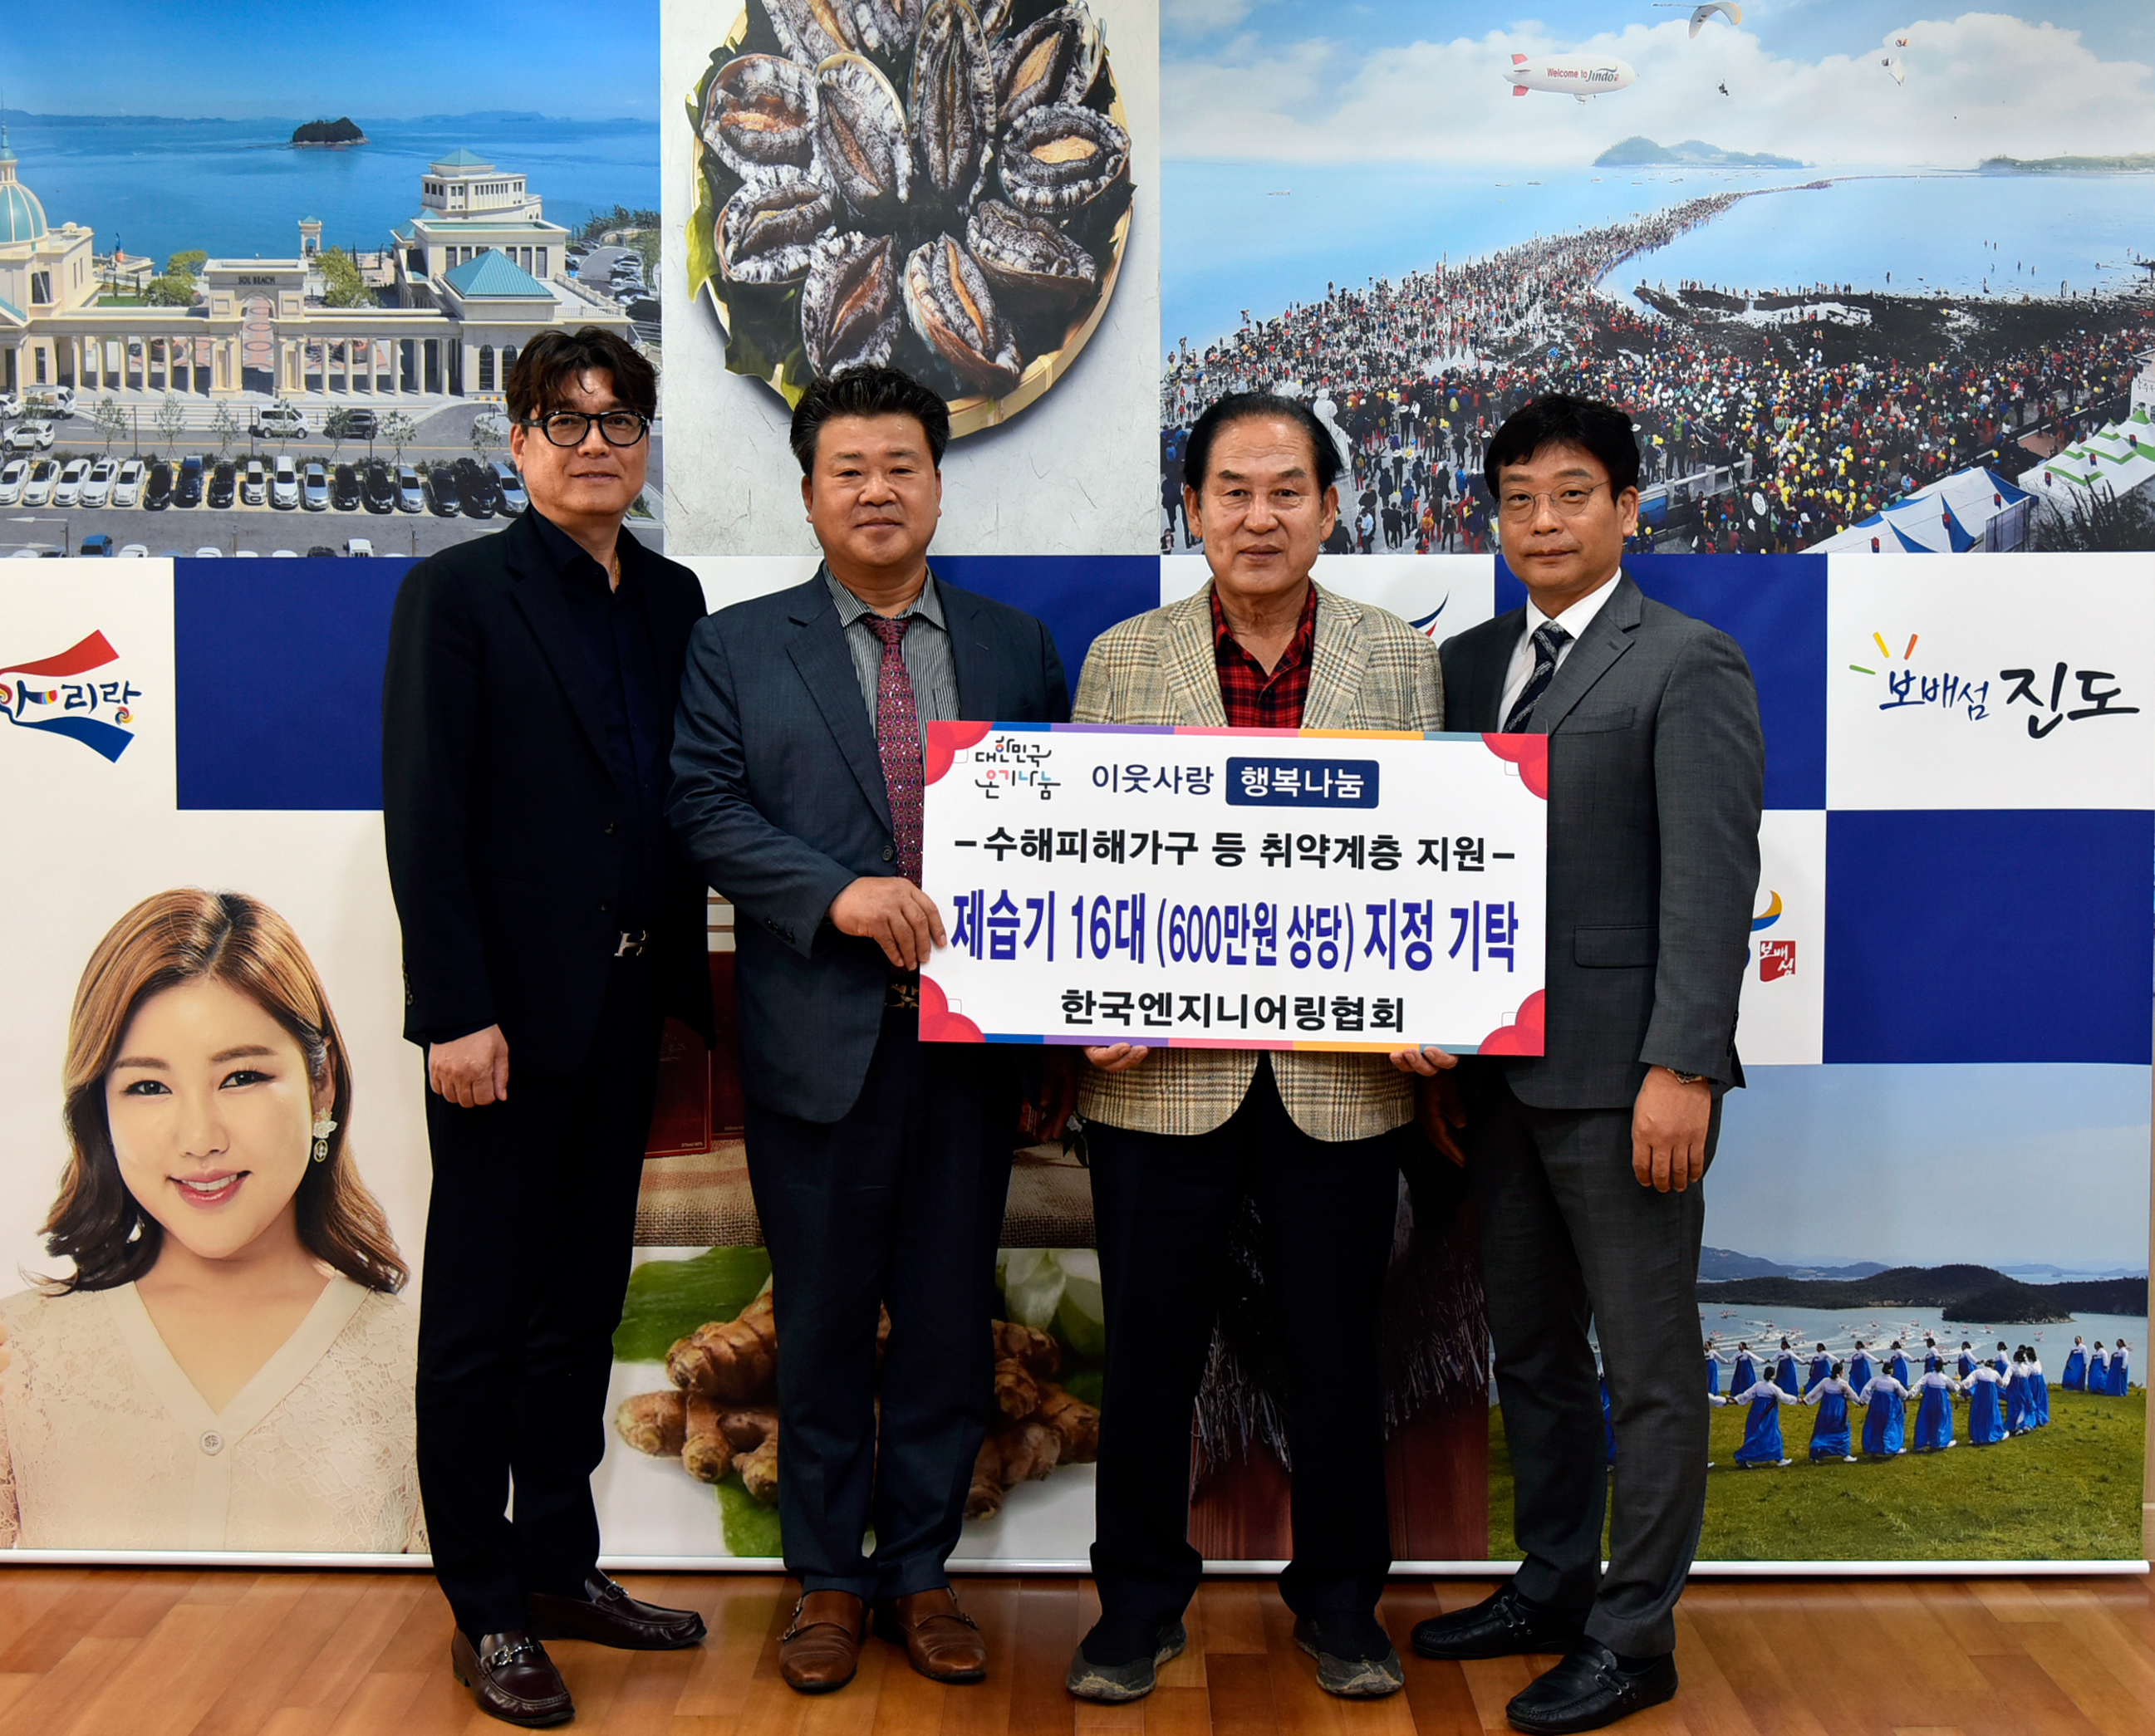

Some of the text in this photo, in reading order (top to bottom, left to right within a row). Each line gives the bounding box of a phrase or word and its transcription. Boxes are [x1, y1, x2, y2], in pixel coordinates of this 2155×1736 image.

[1547, 68, 1578, 78] Welcome
[1581, 69, 1588, 78] to
[1585, 68, 1614, 82] Jindo
[238, 276, 276, 285] SOL BEACH
[1879, 662, 2141, 739] 보배섬 진도
[975, 735, 1052, 768] 대한민국
[974, 769, 1062, 801] 온기나눔
[1092, 763, 1364, 799] 이웃사랑 행복나눔
[1212, 832, 1246, 867] 등
[1260, 832, 1402, 870] 취약계층
[950, 889, 1519, 973] 제습기 16대 (600만원 상당) 지정 기탁
[1061, 989, 1403, 1032] 한국엔지니어링협회
